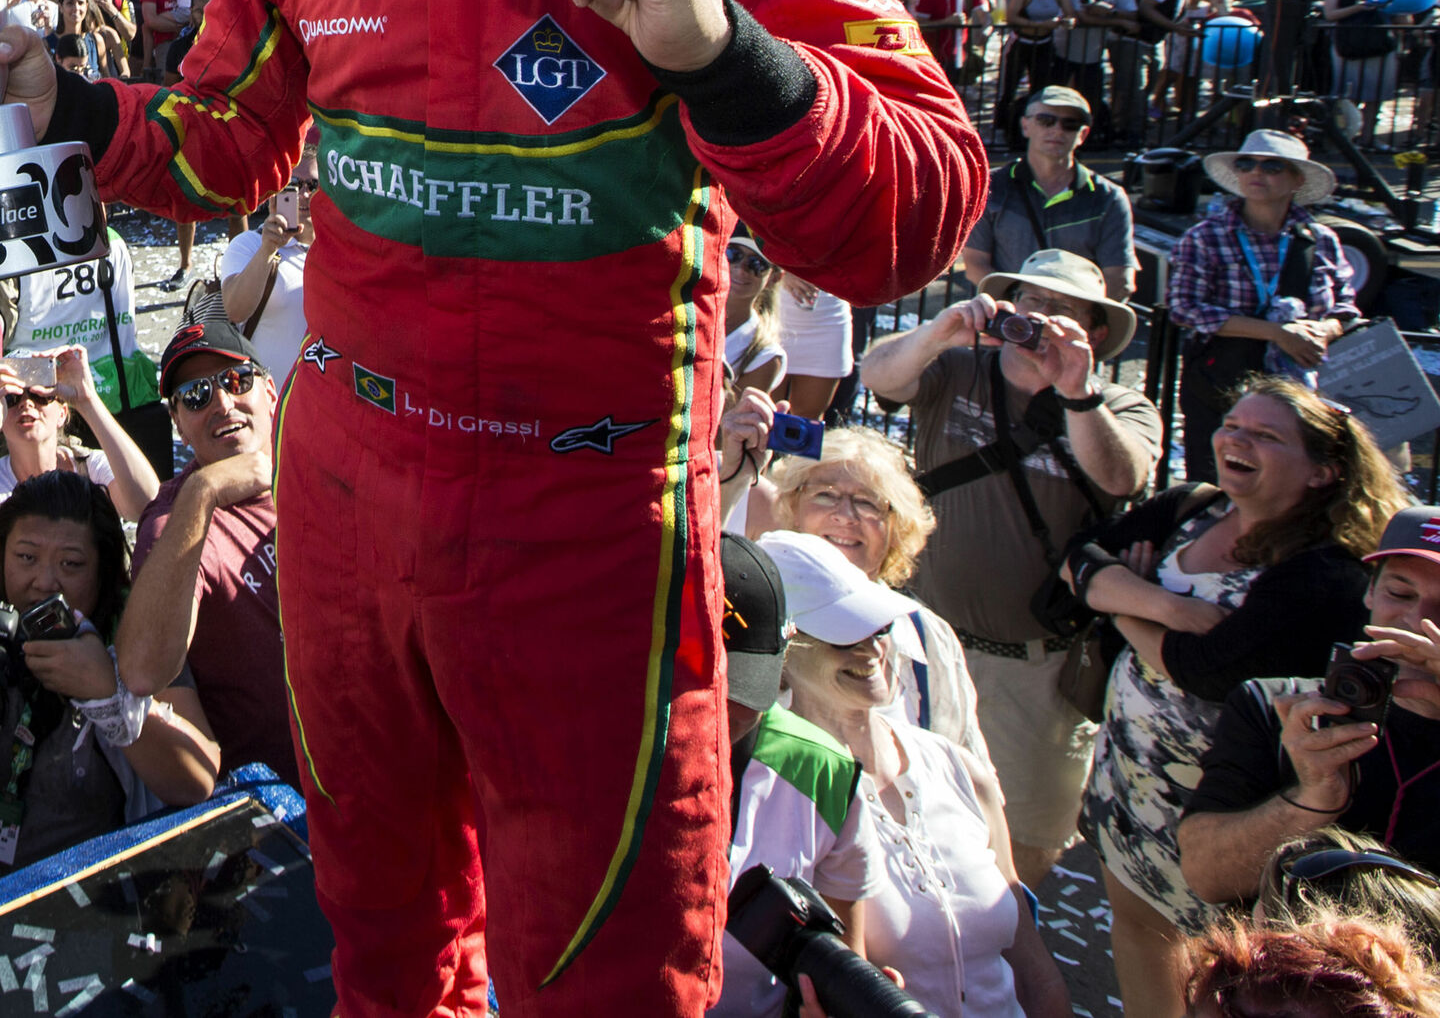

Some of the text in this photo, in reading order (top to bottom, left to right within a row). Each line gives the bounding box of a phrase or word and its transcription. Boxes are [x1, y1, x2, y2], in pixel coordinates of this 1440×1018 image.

[299, 16, 385, 46] QUALCOMM
[511, 53, 589, 89] LGT
[327, 149, 594, 225] SCHAEFFLER
[428, 407, 452, 430] Di
[458, 415, 540, 438] Grassi
